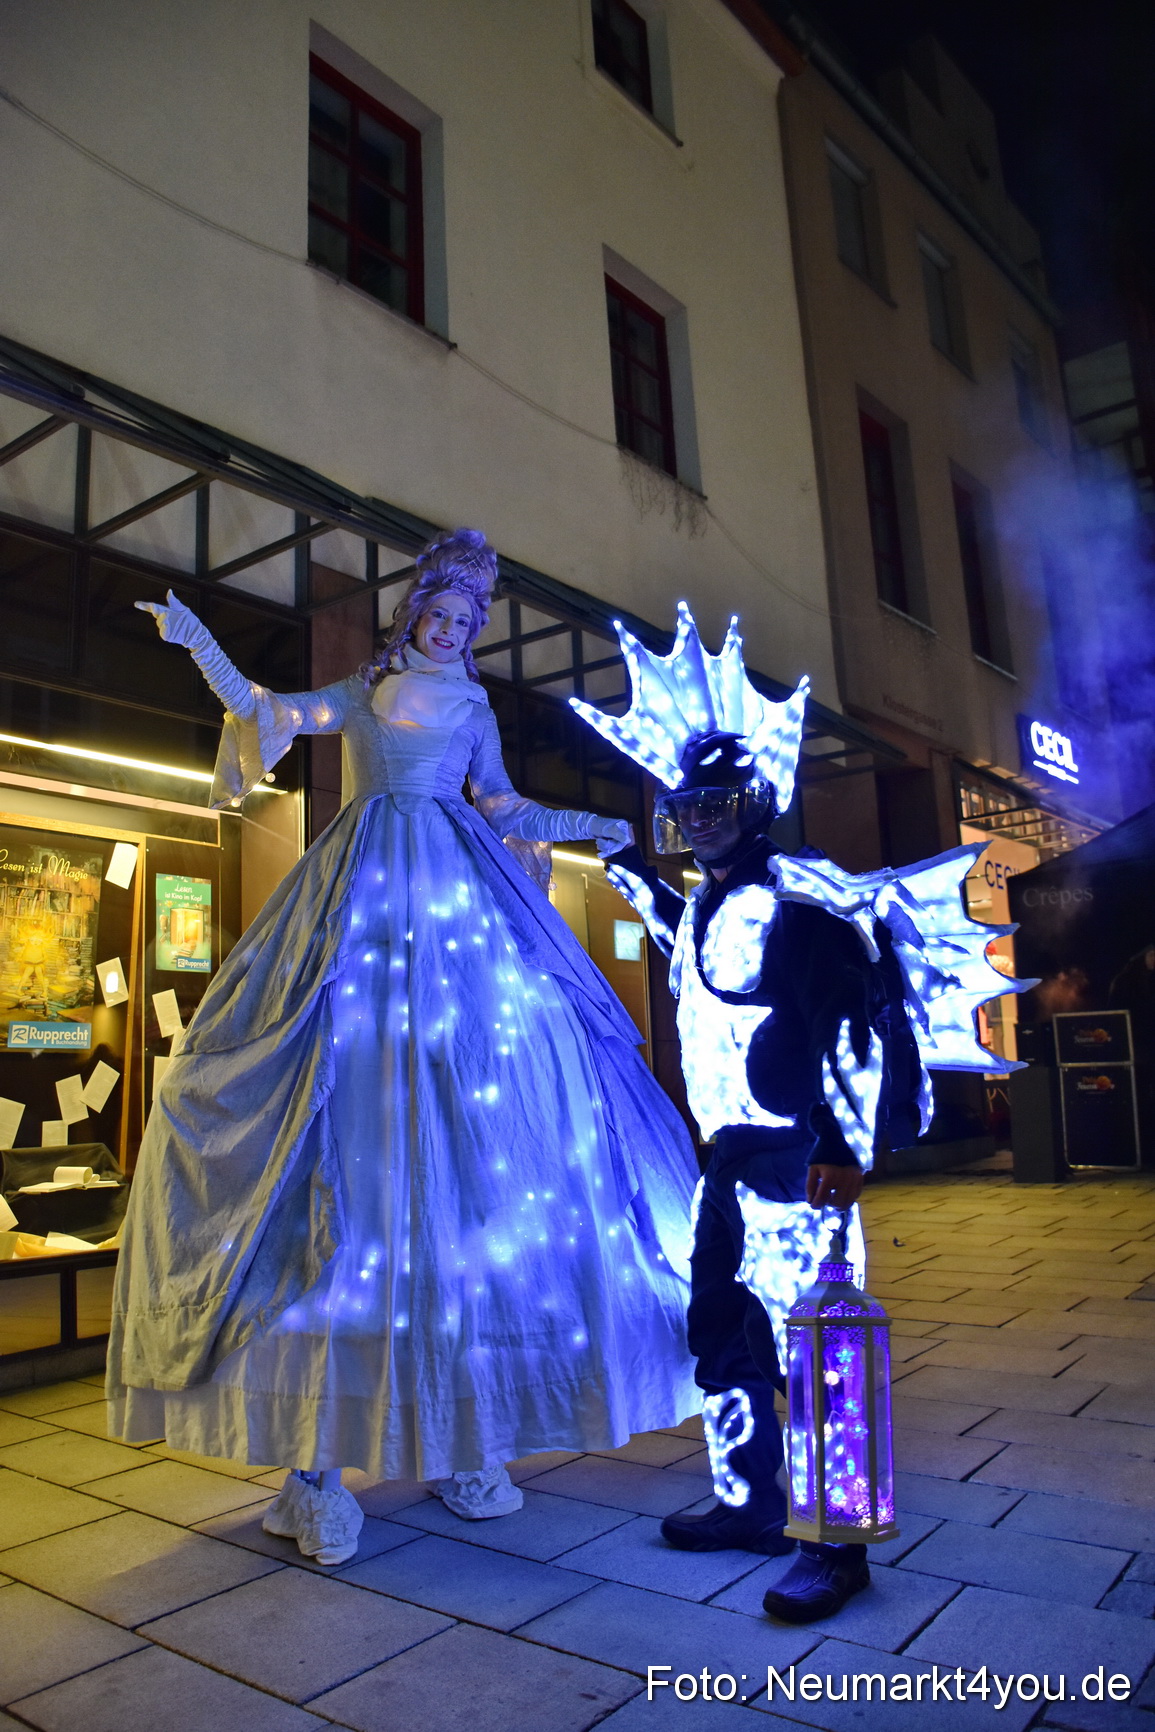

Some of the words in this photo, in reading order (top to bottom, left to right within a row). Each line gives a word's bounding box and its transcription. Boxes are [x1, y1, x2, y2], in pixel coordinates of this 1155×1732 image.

[1030, 721, 1079, 772] CECIL
[30, 863, 43, 874] ist
[48, 855, 89, 882] Magie
[172, 892, 183, 900] Kino
[191, 894, 202, 902] Kopf
[175, 883, 193, 893] Lesen
[1022, 885, 1094, 909] Crêpes
[185, 959, 210, 968] Rupprecht
[29, 1026, 88, 1045] Rupprecht
